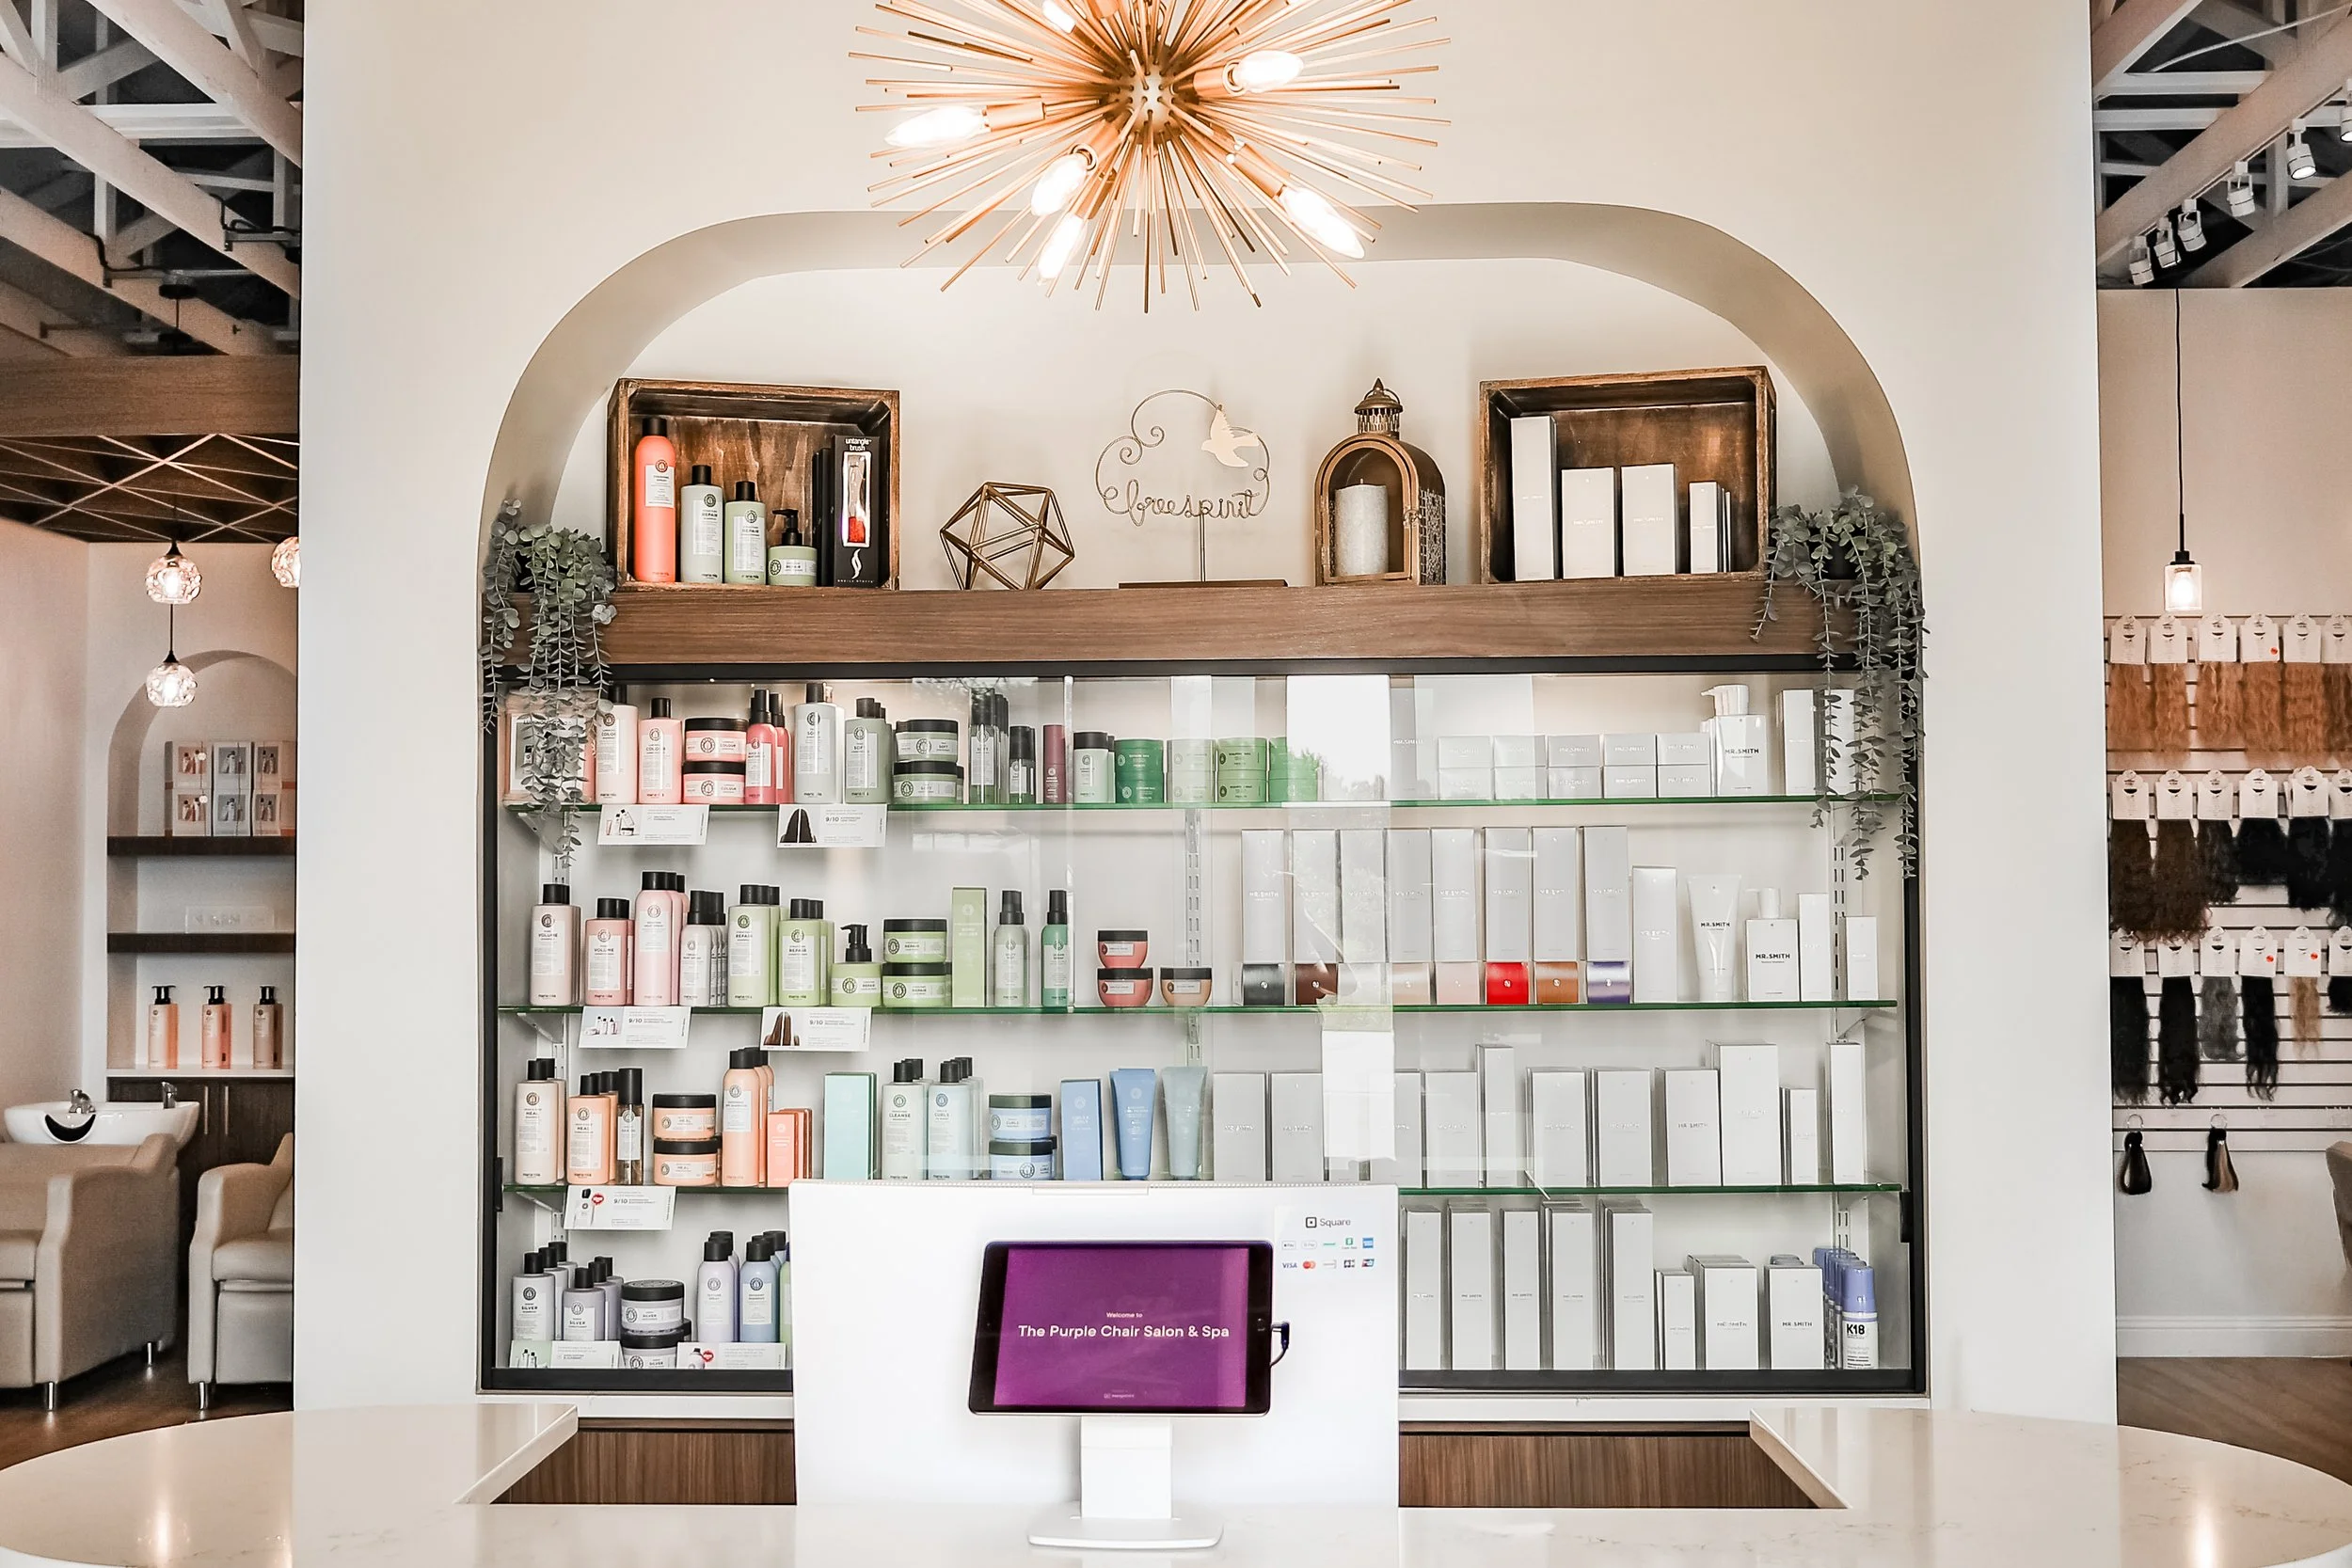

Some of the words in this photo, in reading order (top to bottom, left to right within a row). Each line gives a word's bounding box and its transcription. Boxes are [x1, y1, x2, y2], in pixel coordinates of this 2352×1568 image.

[846, 437, 870, 446] untangle
[1319, 1217, 1351, 1227] Square
[1018, 1324, 1045, 1337] The
[1049, 1324, 1096, 1339] Purple
[1101, 1324, 1139, 1337] Chair
[1143, 1324, 1184, 1338] Salon
[1187, 1324, 1199, 1338] &
[1201, 1324, 1230, 1339] Spa
[1846, 1323, 1865, 1335] K18
